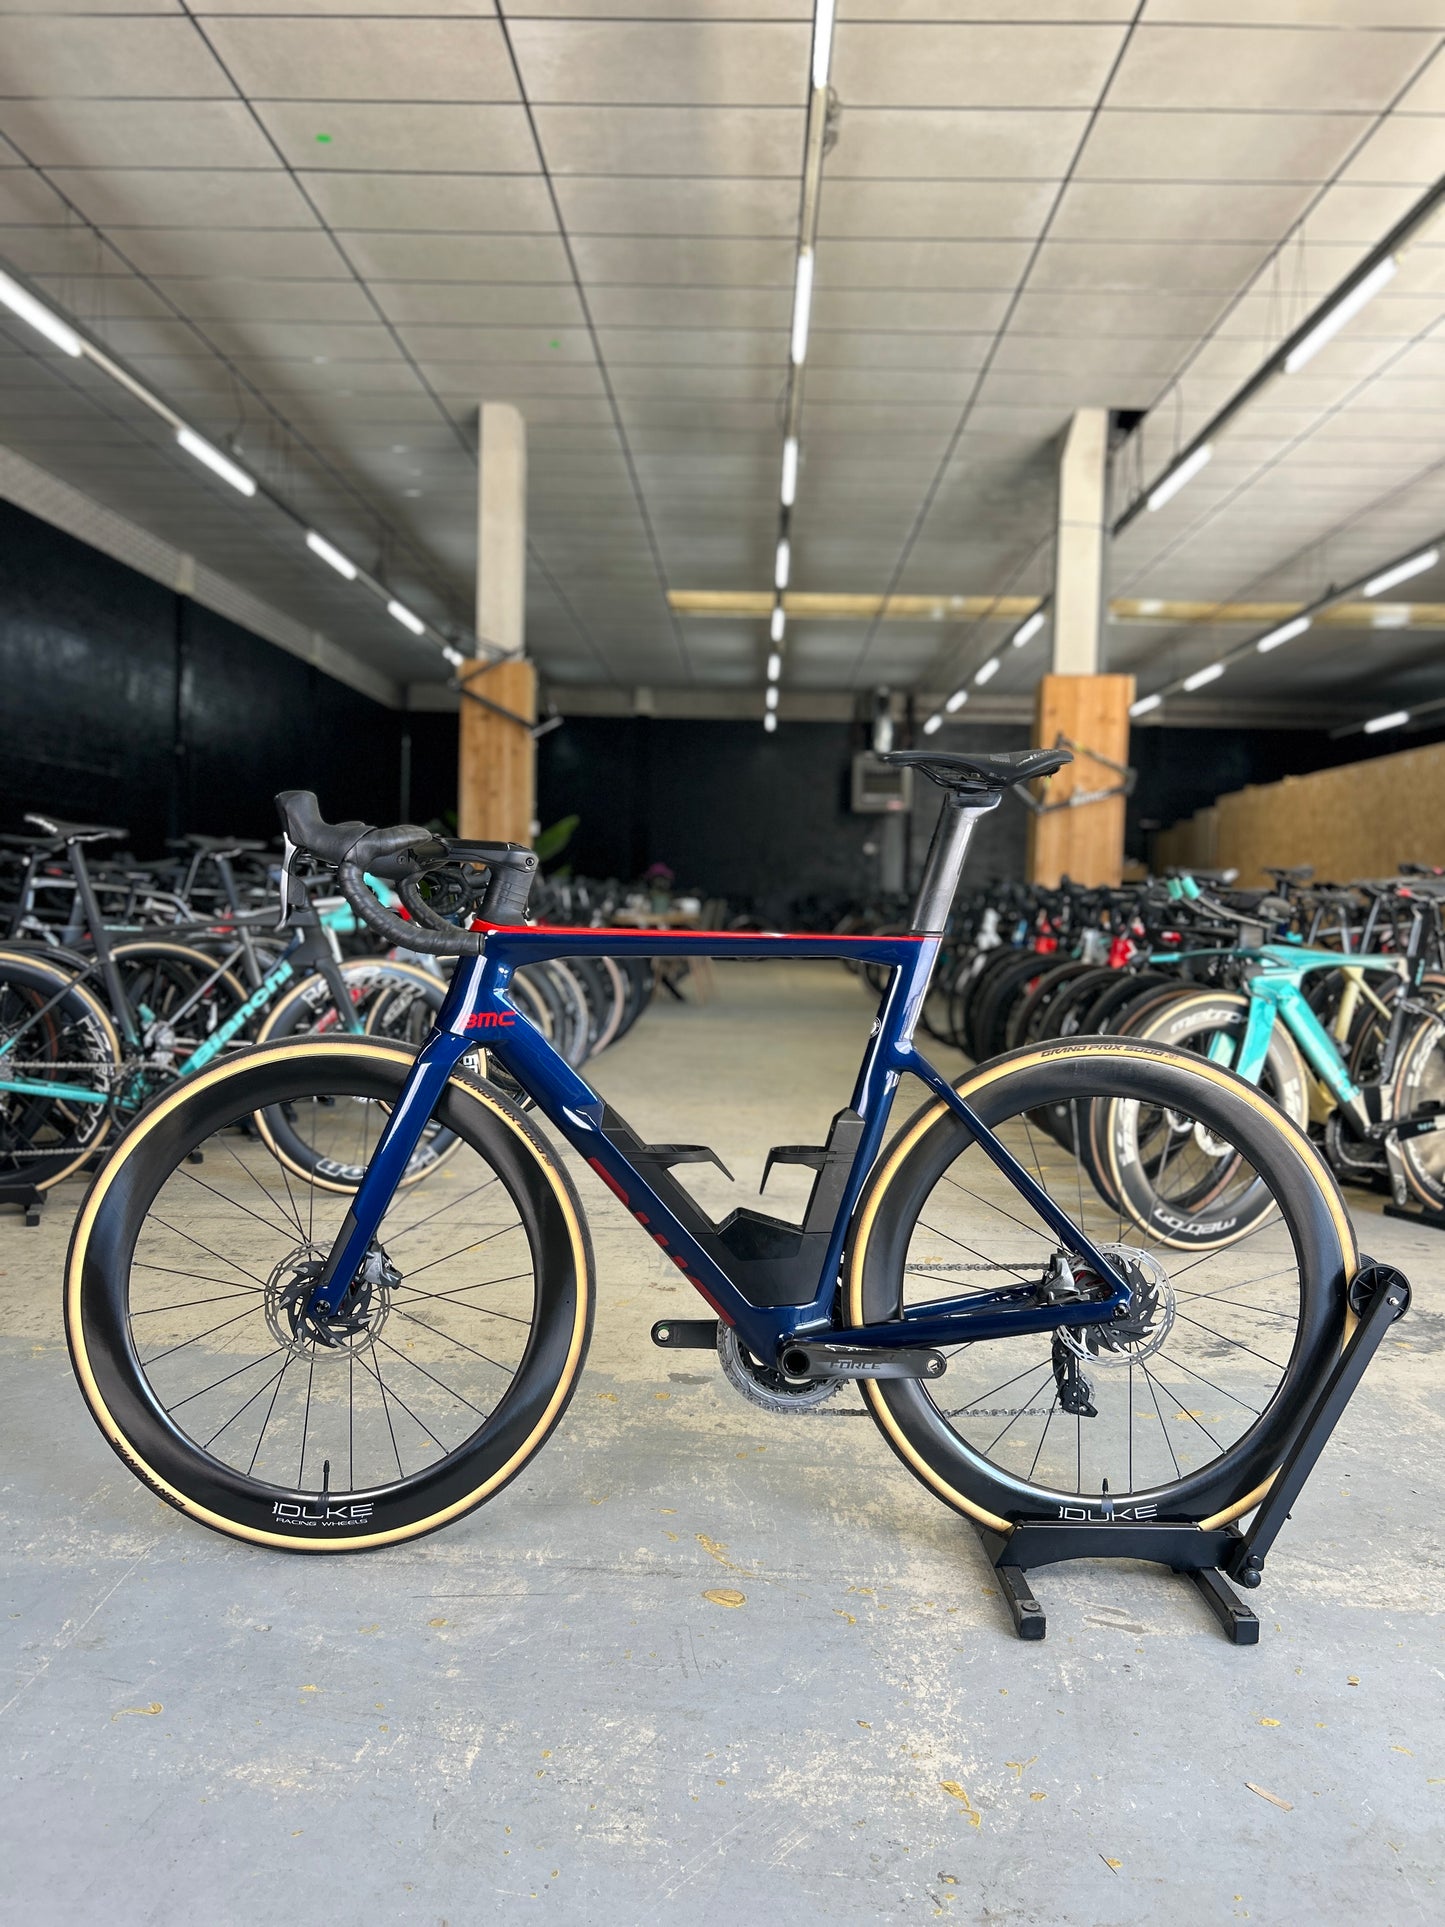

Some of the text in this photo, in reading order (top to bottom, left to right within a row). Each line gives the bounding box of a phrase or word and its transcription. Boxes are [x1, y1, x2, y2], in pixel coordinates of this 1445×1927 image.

[191, 960, 294, 1069] Bianchi
[462, 1010, 516, 1029] BMC
[1039, 1044, 1086, 1058] GRAND
[1123, 1044, 1164, 1057] 5000
[1153, 1207, 1237, 1236] metron
[829, 1359, 881, 1370] FORCE
[113, 1437, 186, 1507] CONTINENTAL
[275, 1517, 368, 1527] RACING WHEELS
